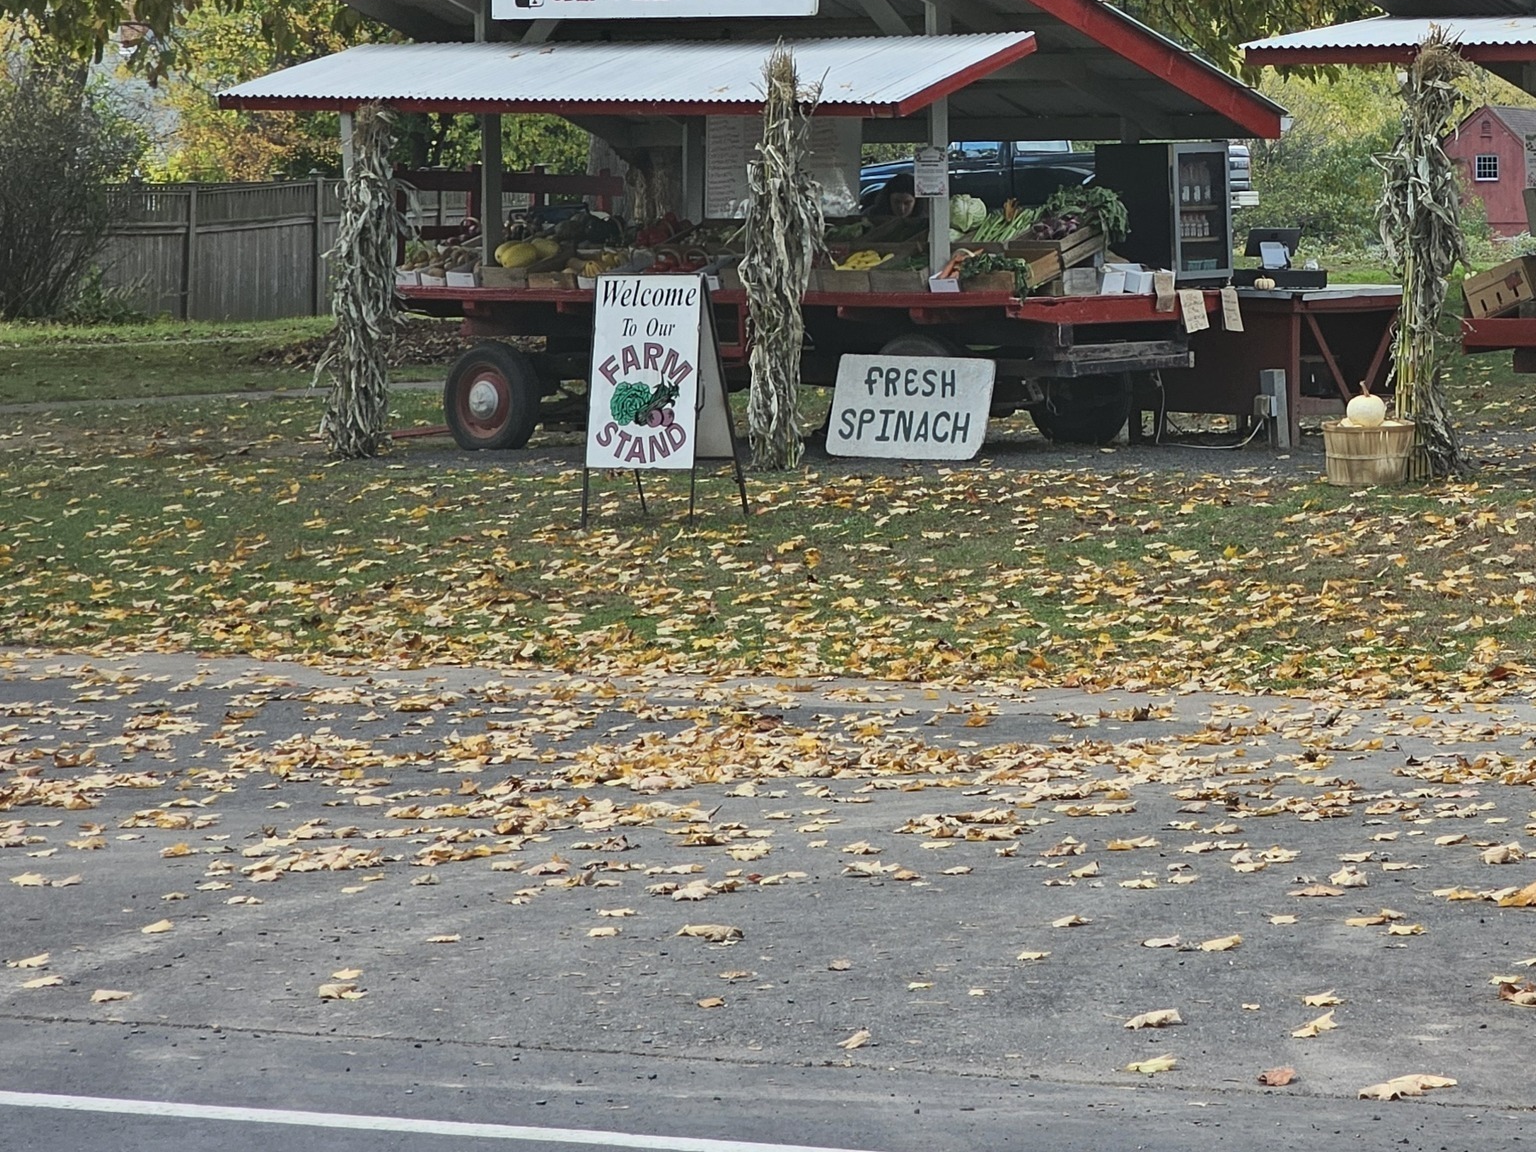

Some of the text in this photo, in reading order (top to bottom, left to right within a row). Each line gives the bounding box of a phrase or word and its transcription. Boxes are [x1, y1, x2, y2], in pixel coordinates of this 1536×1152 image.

[601, 280, 697, 308] Welcome
[622, 318, 676, 337] To Our
[598, 342, 693, 386] FARM
[596, 422, 687, 464] STAND
[838, 408, 970, 443] SPINACH
